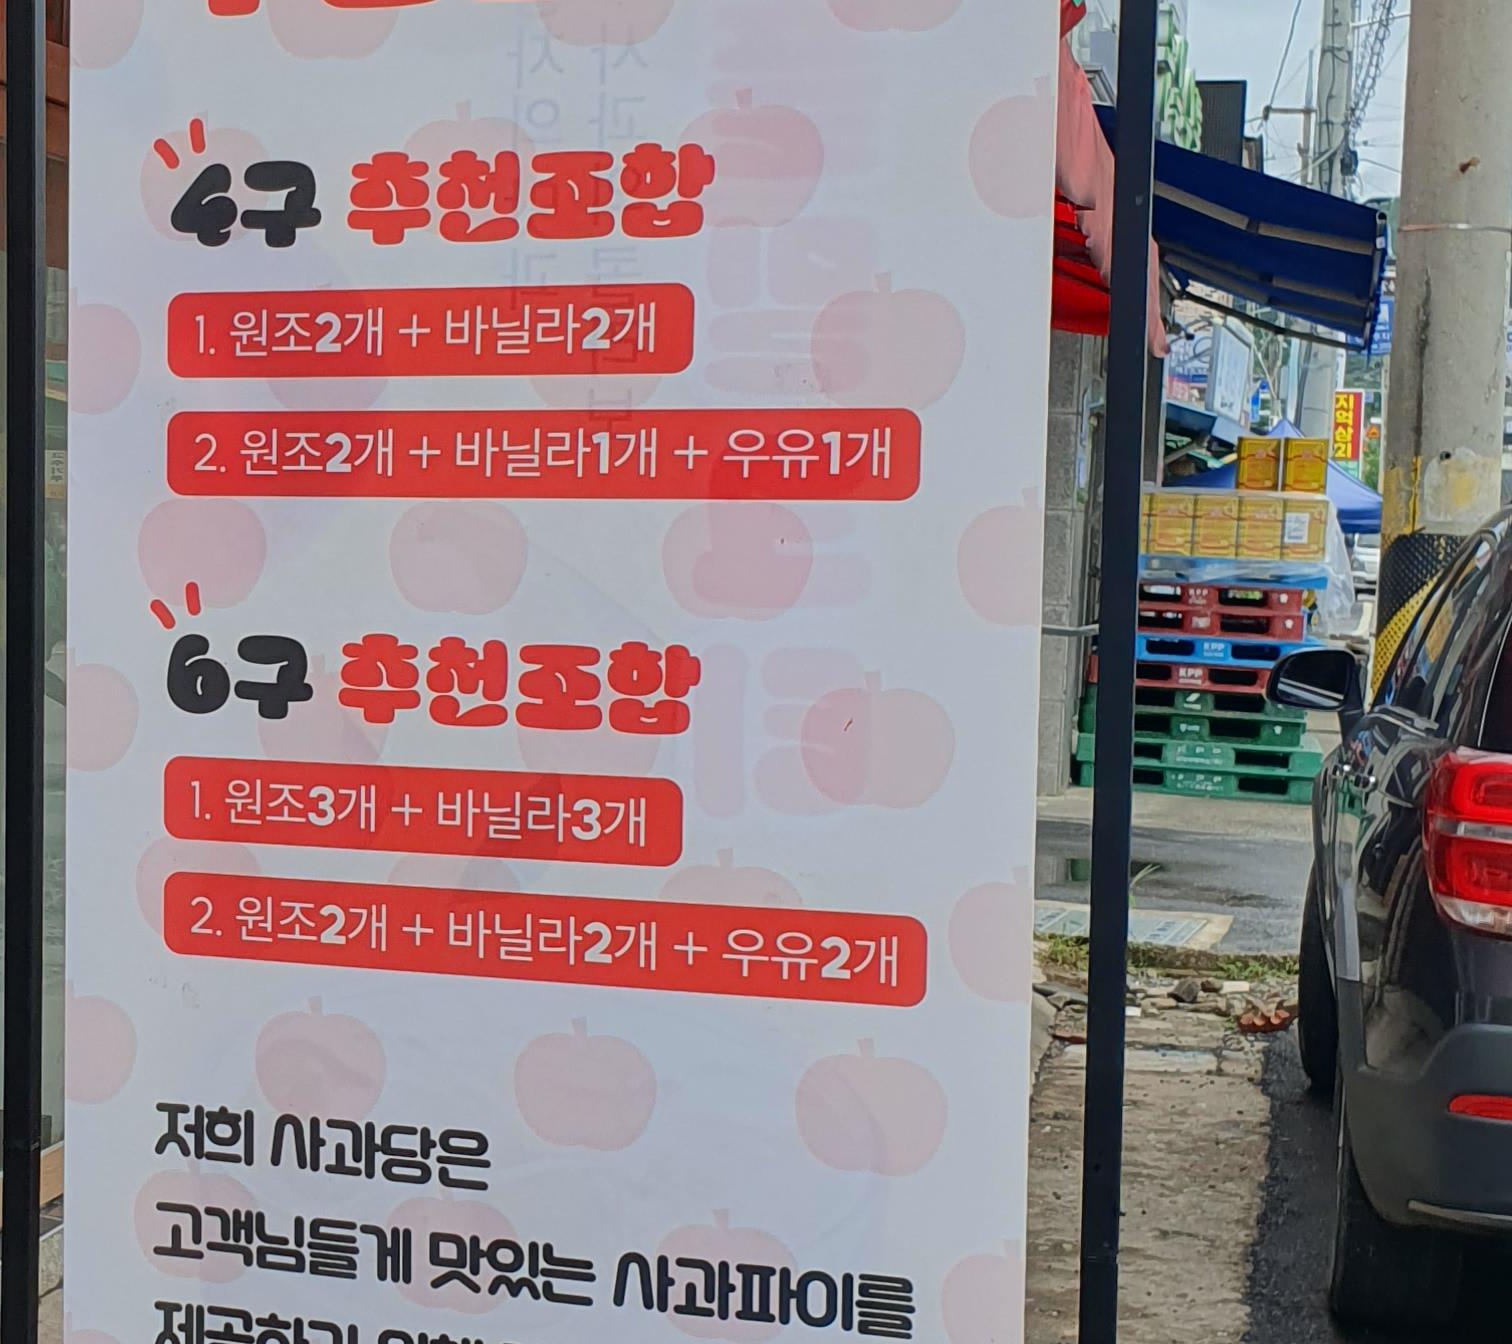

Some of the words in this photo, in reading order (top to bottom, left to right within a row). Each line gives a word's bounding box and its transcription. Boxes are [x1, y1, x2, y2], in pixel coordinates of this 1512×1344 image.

[170, 160, 322, 248] 4구
[347, 143, 715, 244] 추천조합
[230, 307, 383, 356] 원조2개
[446, 302, 655, 355] 바닐라2개
[240, 428, 393, 477] 원조2개
[456, 427, 657, 478] 바닐라1개
[723, 427, 891, 479] 우유1개
[166, 633, 314, 720] 6구
[338, 635, 701, 736] 추천조합
[225, 779, 376, 832] 원조3개
[438, 789, 646, 847] 바닐라3개
[236, 896, 387, 952] 원조2개
[449, 911, 656, 971] 바닐라2개
[722, 929, 898, 987] 우유2개
[154, 1102, 254, 1167] 저희
[270, 1113, 491, 1191] 사과당은
[153, 1202, 412, 1285] 고객님들게
[428, 1231, 597, 1307] 맛있는
[612, 1251, 916, 1340] 사과파이를
